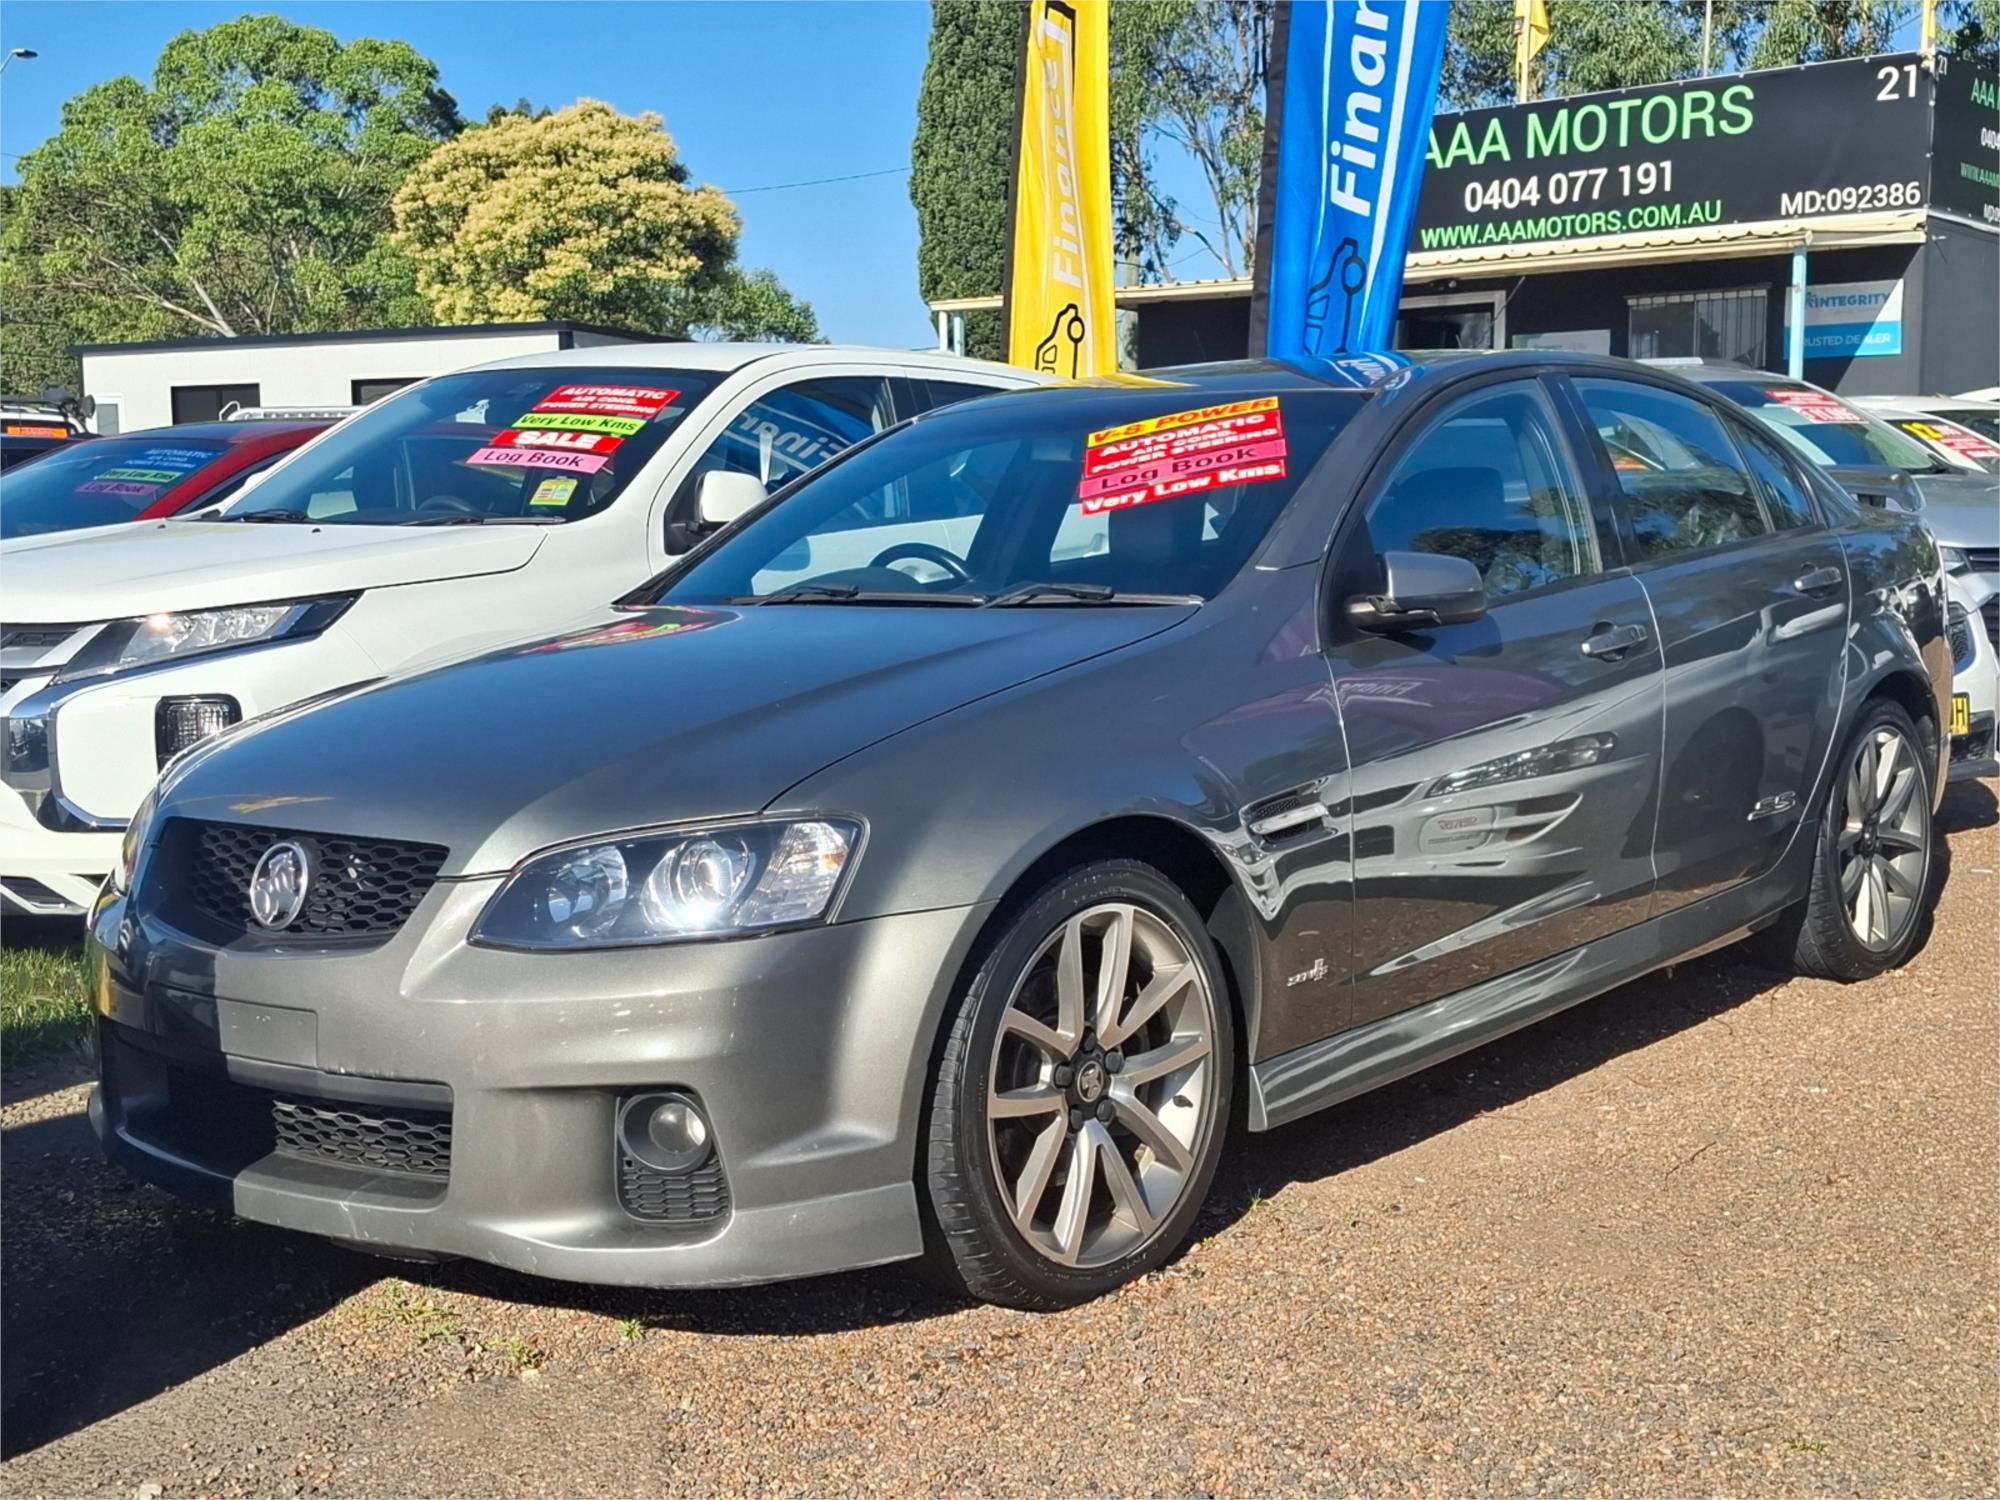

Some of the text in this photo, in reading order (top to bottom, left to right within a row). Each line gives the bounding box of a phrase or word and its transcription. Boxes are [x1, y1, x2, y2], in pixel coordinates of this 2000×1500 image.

[1877, 64, 1918, 101] 21
[1971, 78, 1996, 110] AAA
[1527, 85, 1755, 159] MOTORS
[1044, 58, 1082, 288] Finance
[1465, 160, 1672, 213] 0404 077 191
[1781, 181, 1922, 216] MD:092386
[1421, 199, 1721, 249] WWW.AAAMOTORS.COM.AU
[1814, 293, 1890, 309] INTEGRITY
[1845, 333, 1891, 345] DEALER
[560, 387, 668, 400] AUTOMATIC
[589, 403, 657, 413] STEERING
[521, 415, 638, 431] Very Low Kms
[1094, 399, 1274, 442] V-8 POWER
[1099, 414, 1266, 456] AUTOMATIC
[513, 430, 603, 449] SALE
[1091, 428, 1278, 473] POWER STEERING
[1131, 443, 1168, 457] AIR
[484, 451, 585, 468] Log Book
[1101, 448, 1260, 489] Log Book
[1085, 464, 1281, 512] Very Low Kms
